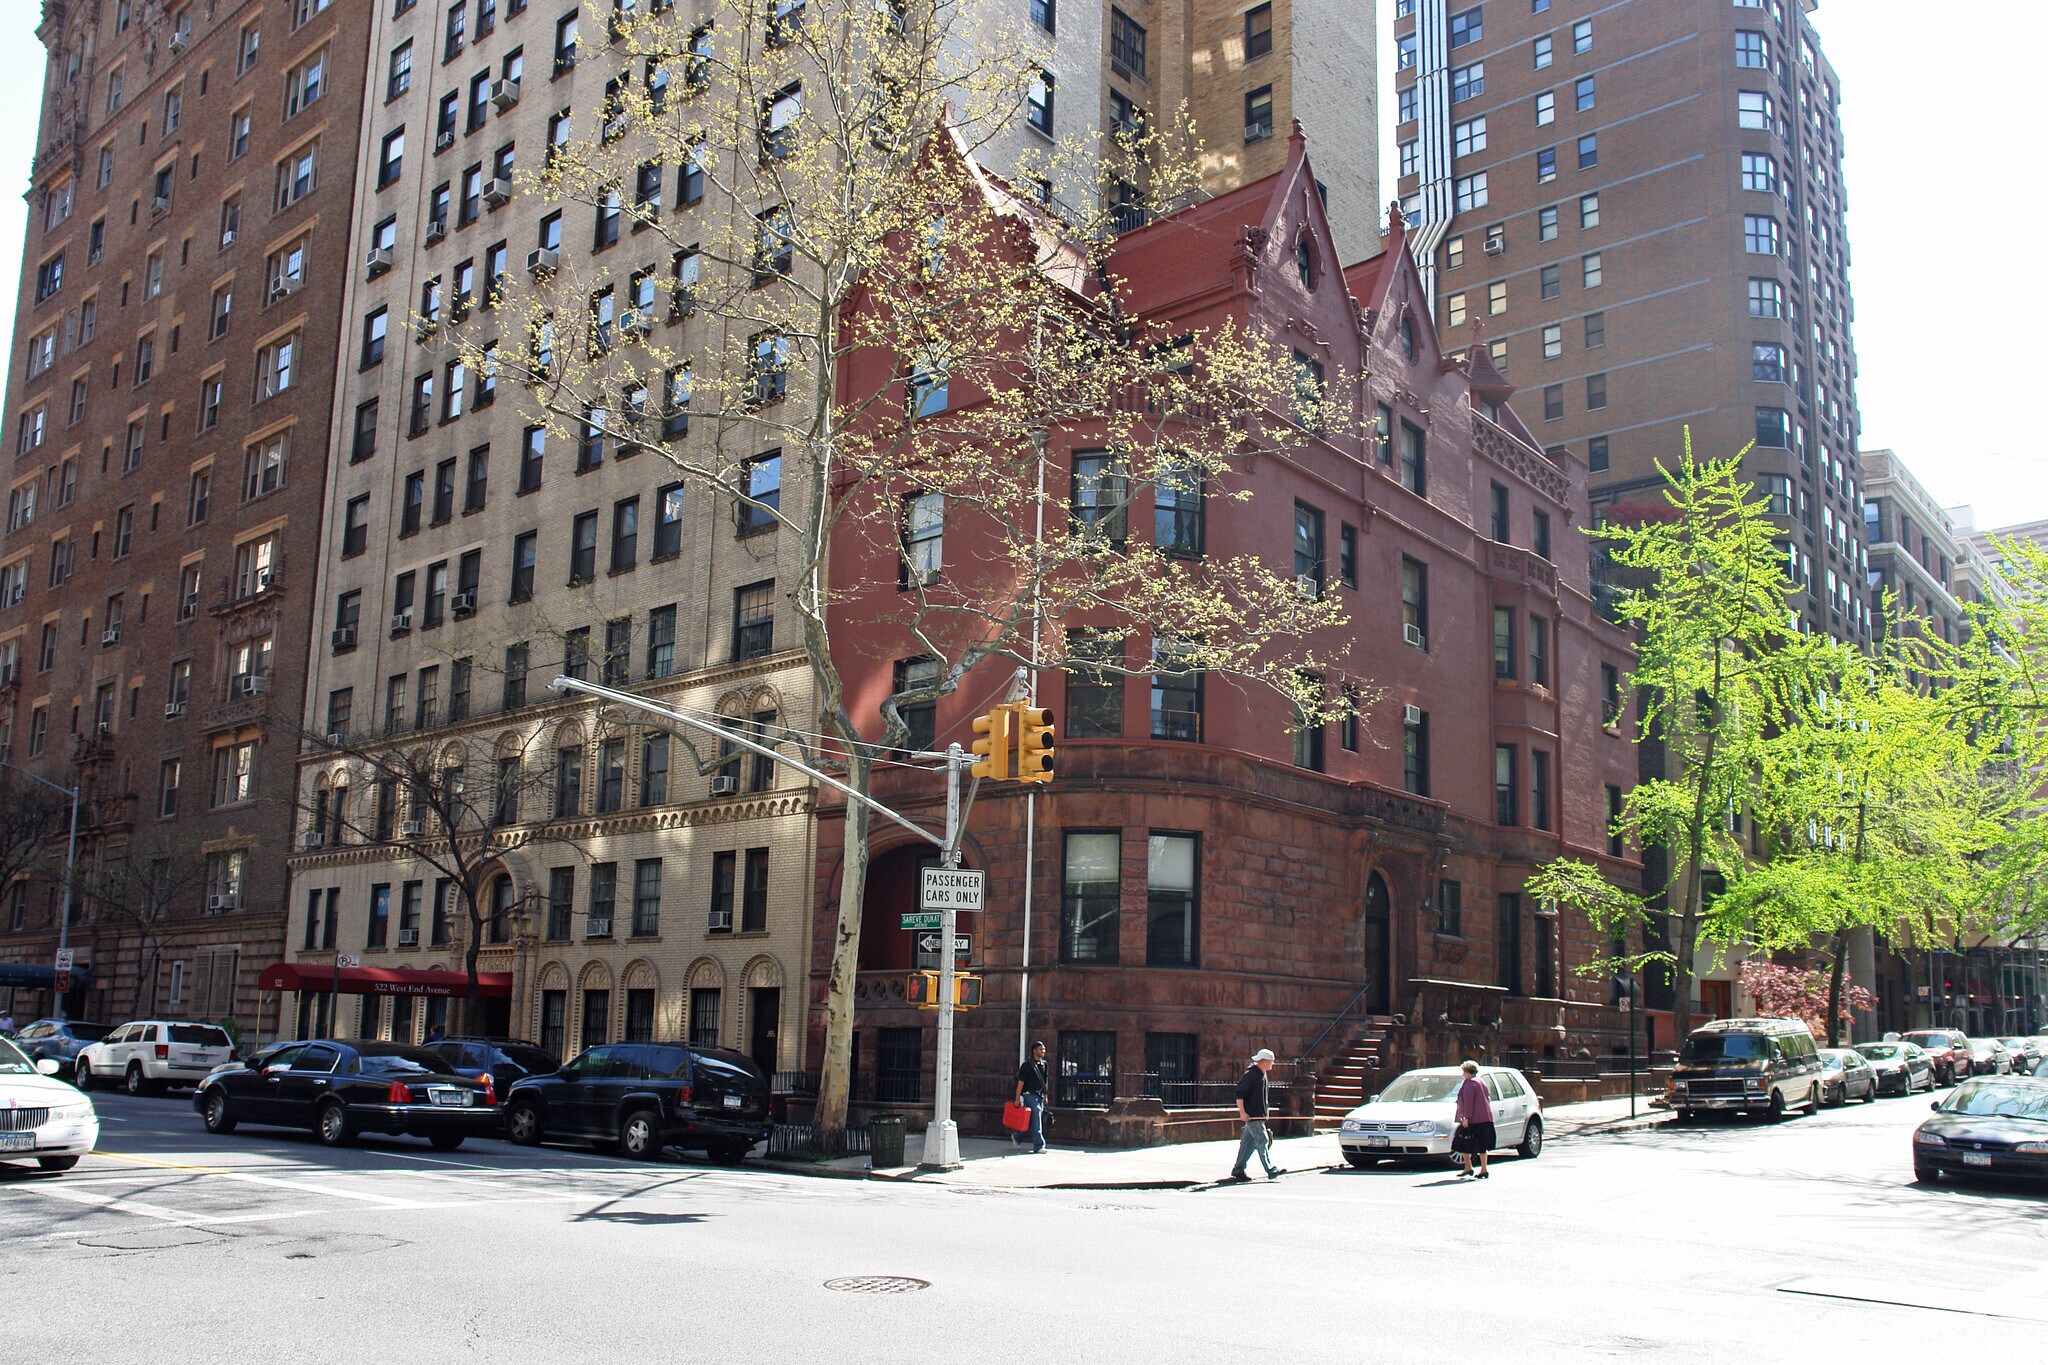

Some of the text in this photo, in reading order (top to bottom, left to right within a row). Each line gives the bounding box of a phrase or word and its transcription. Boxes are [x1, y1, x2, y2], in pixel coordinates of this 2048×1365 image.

[926, 874, 980, 887] PASSENGER
[925, 889, 979, 903] CARS ONLY
[925, 939, 938, 948] ONE
[374, 983, 451, 994] 522 West End Avenue
